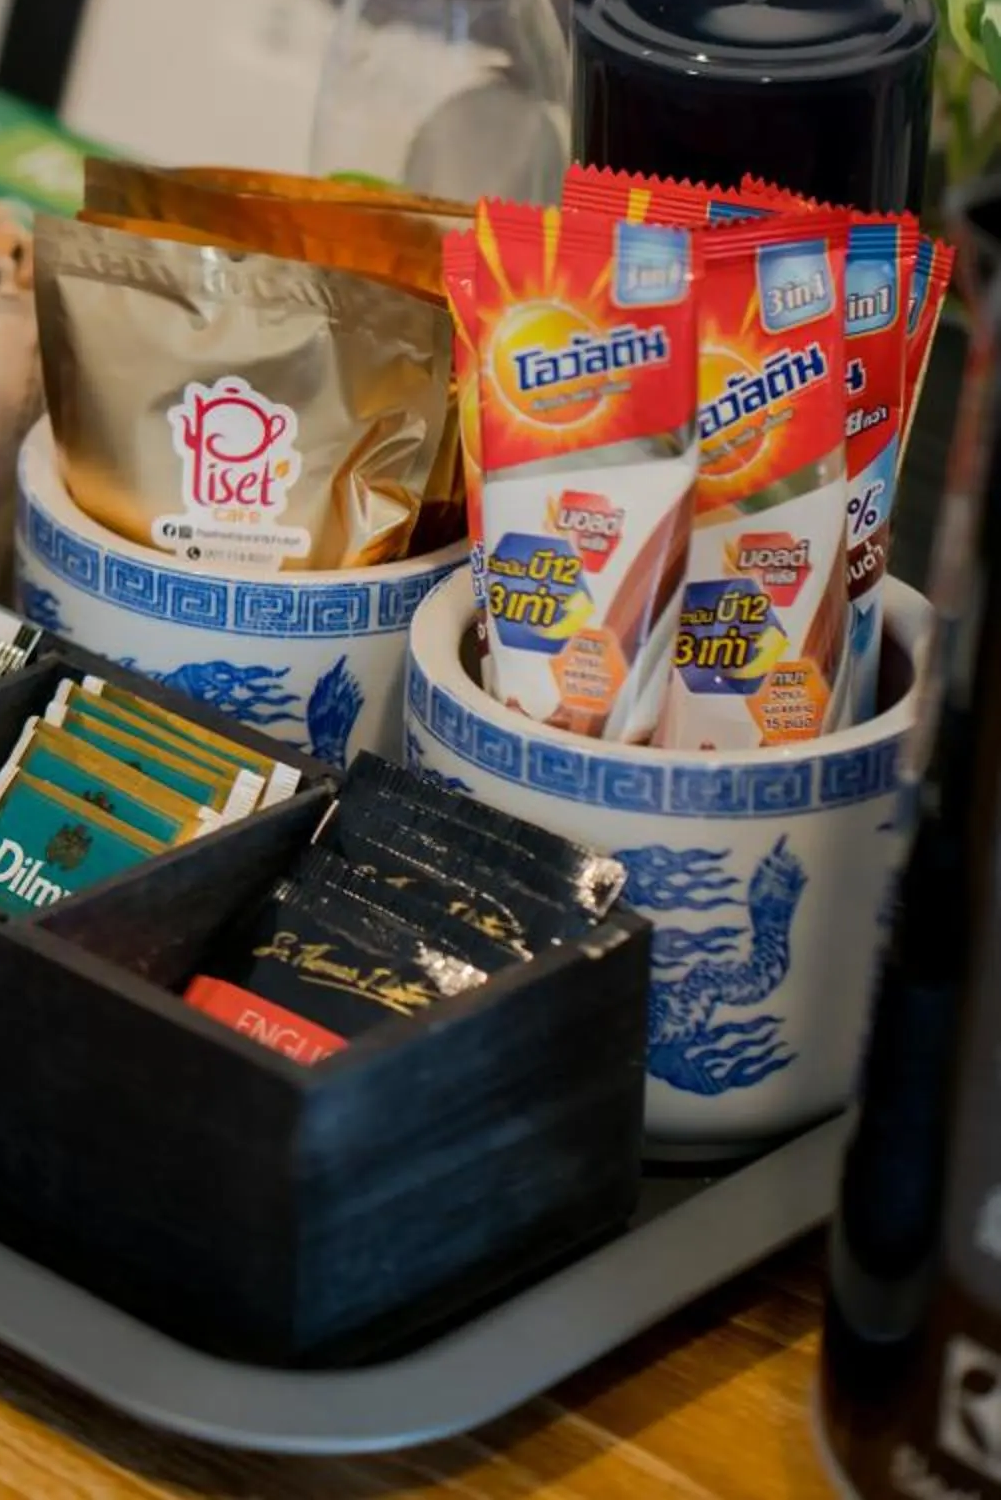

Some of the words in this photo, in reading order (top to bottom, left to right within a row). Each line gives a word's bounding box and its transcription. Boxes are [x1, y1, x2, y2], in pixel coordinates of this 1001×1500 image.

[767, 271, 827, 316] 3in1
[847, 285, 892, 322] in1
[514, 326, 668, 392] โอวัลติน
[699, 344, 827, 440] อวัลติน
[234, 1008, 336, 1067] ENGLI
